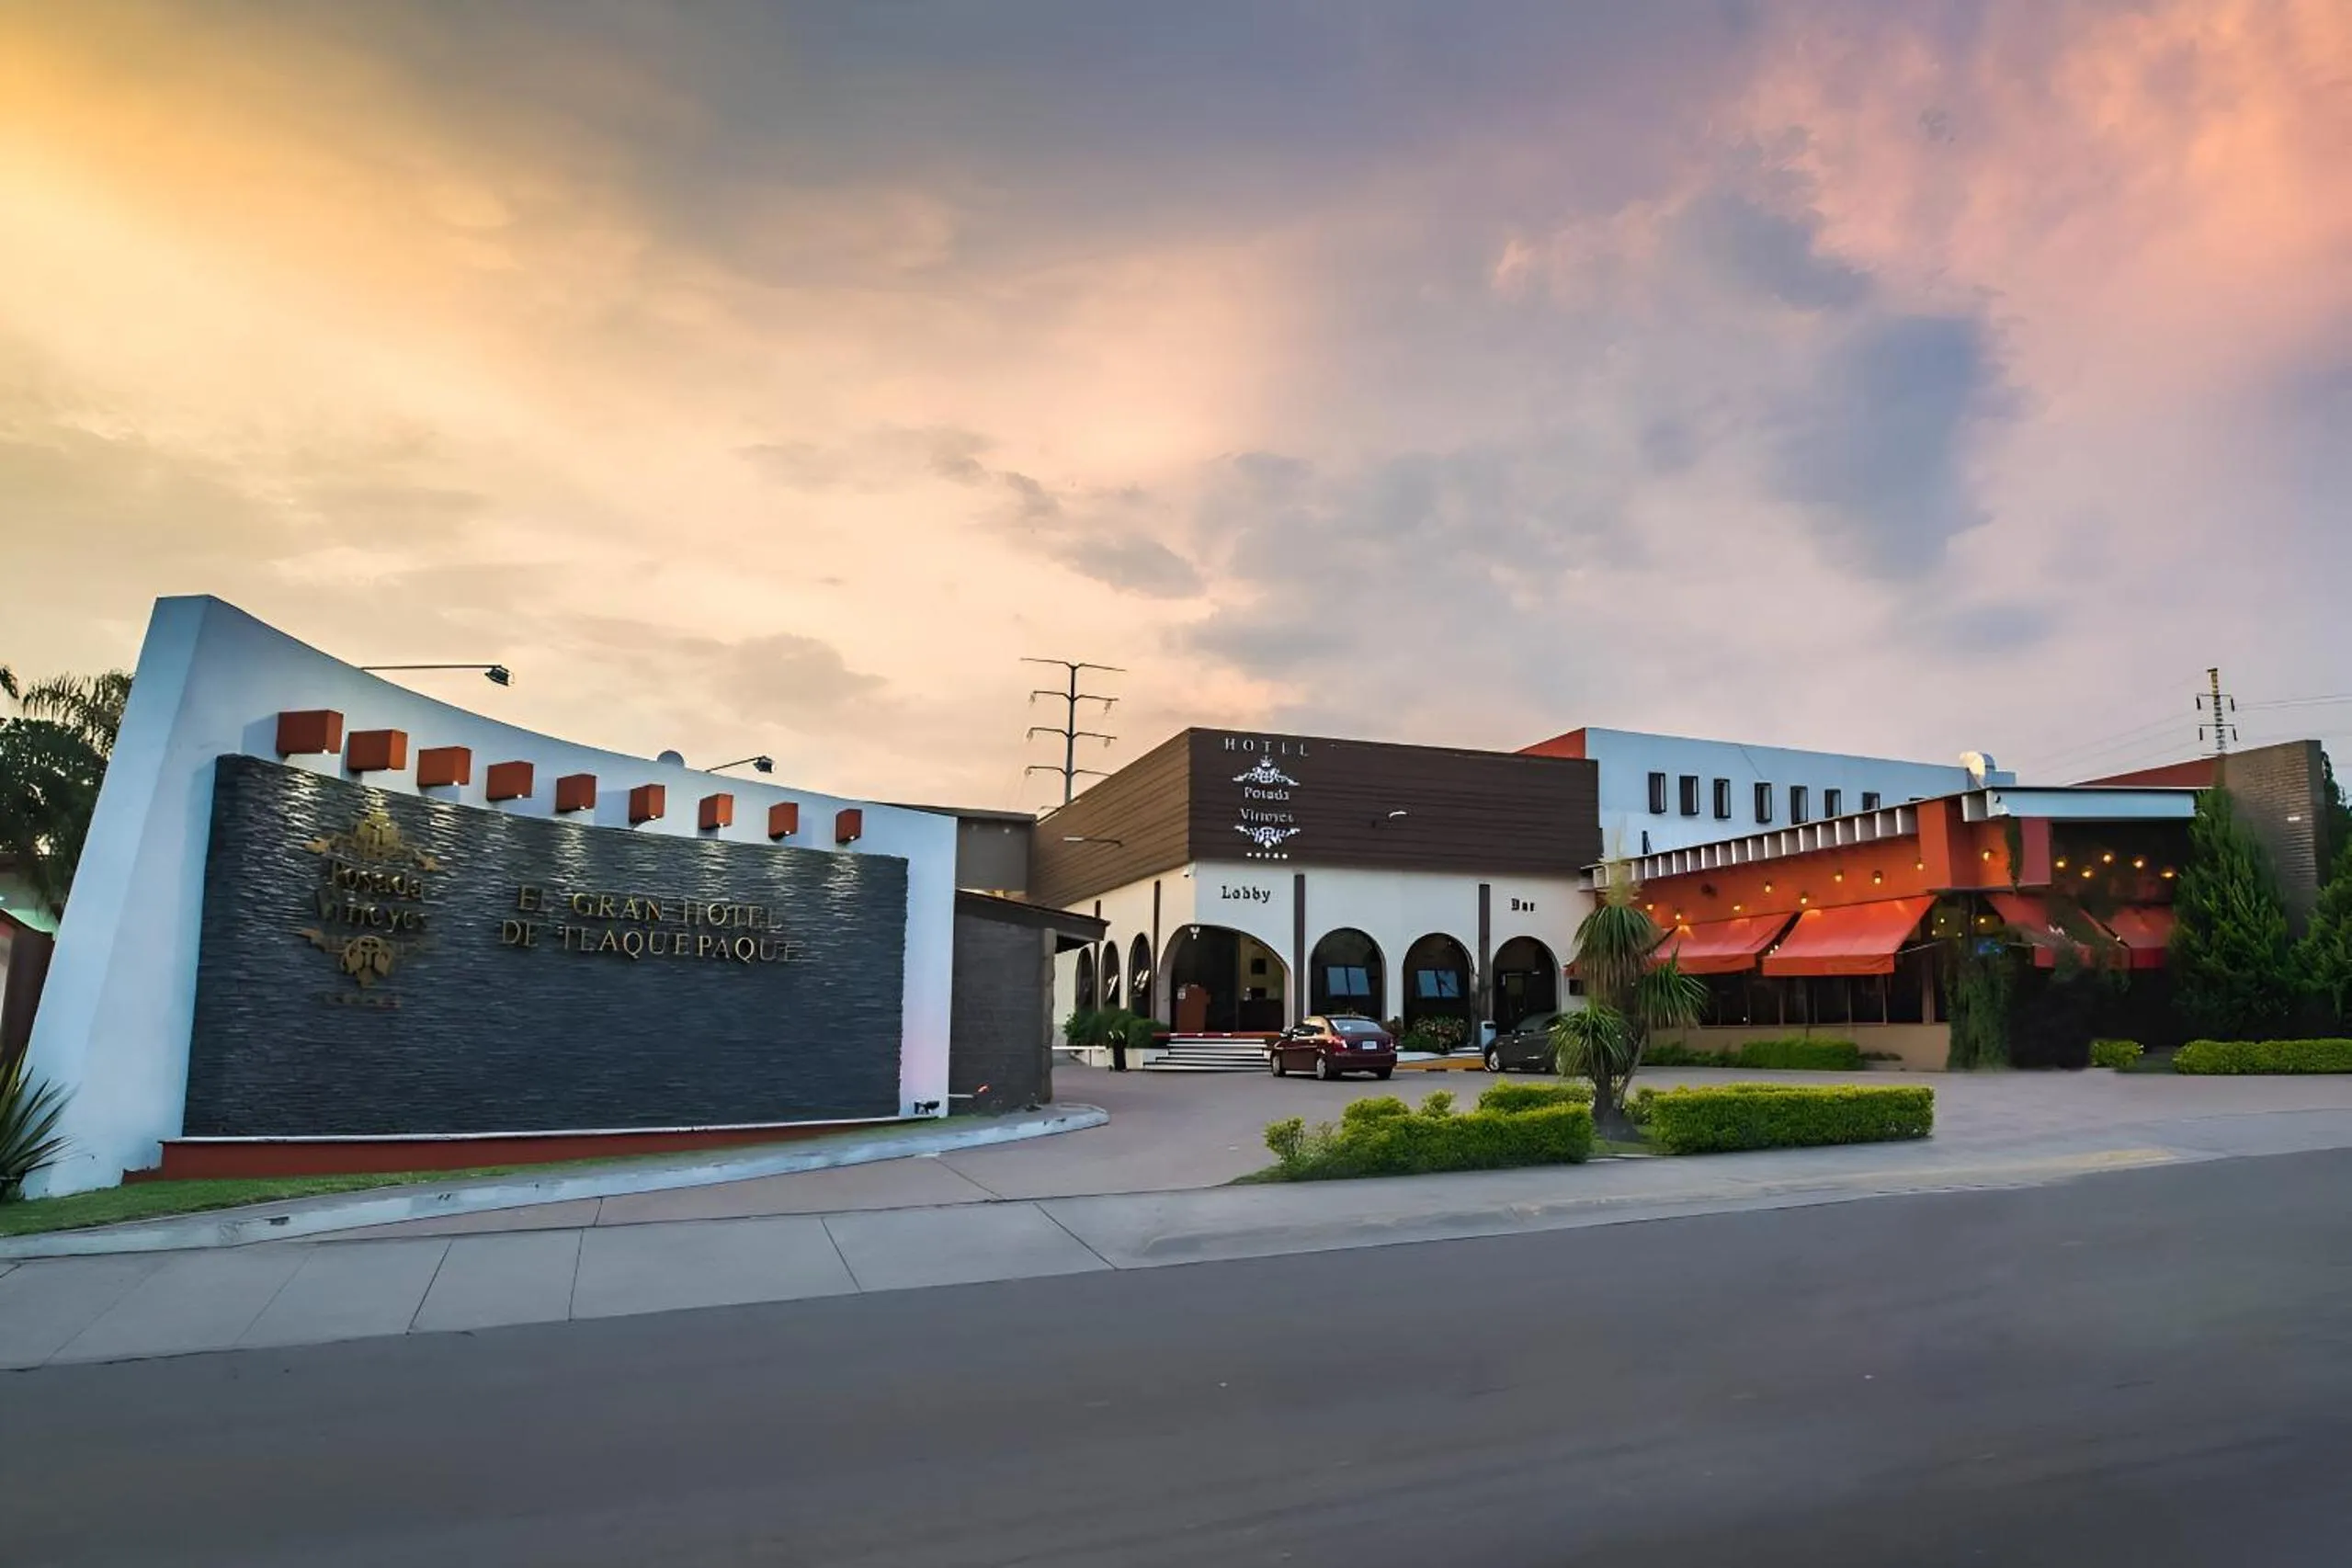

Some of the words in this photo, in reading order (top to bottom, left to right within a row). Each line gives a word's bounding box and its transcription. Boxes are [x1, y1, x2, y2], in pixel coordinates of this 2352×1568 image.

[517, 884, 553, 912] EL
[573, 892, 663, 922] GRAN
[683, 898, 784, 929] HOTEL
[1221, 885, 1272, 903] Lobby
[499, 918, 540, 948] DE
[560, 925, 805, 964] TLAQUEPAQUE
